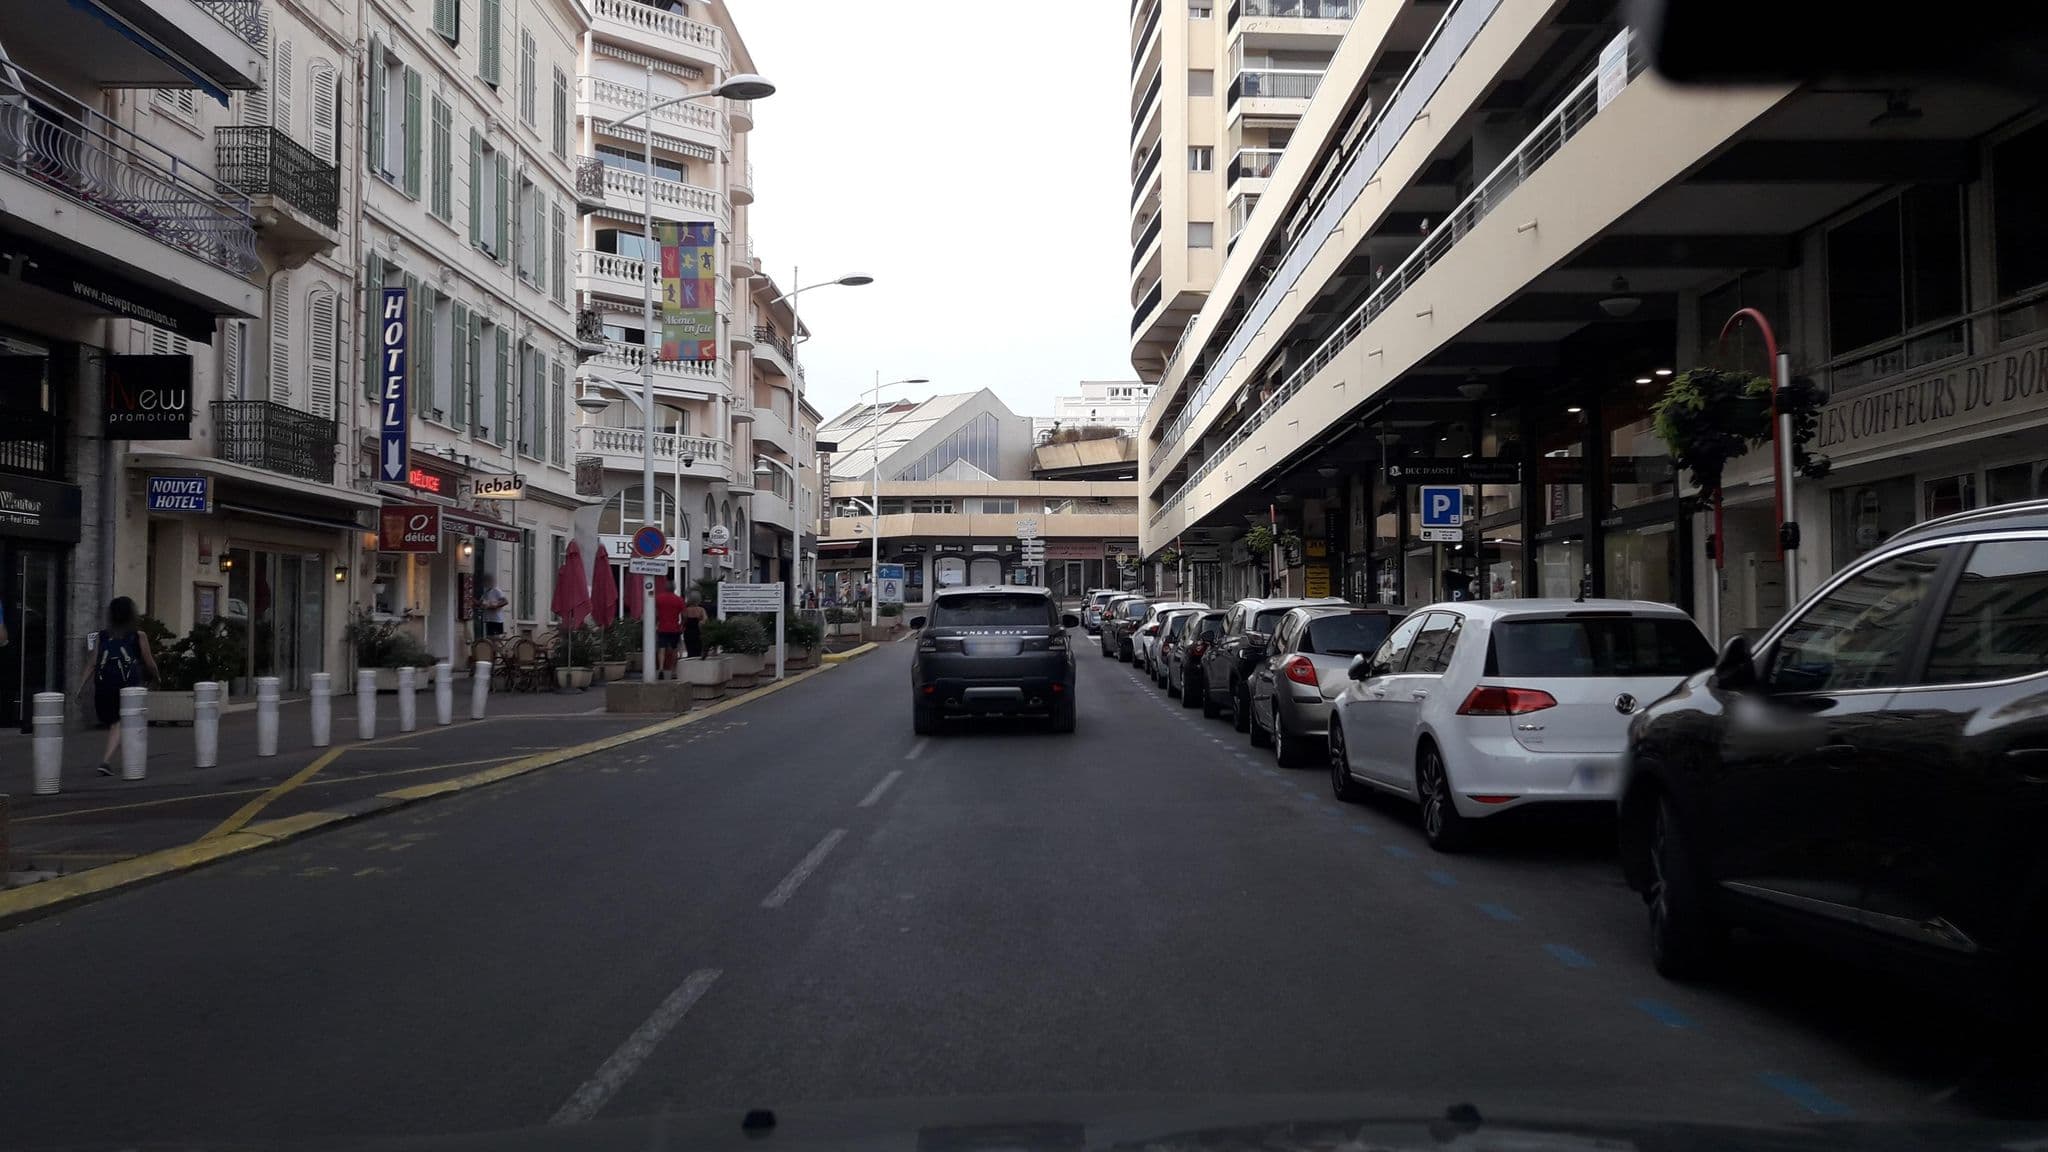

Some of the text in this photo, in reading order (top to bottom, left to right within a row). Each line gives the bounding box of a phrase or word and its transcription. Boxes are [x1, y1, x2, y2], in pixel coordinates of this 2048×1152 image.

[384, 295, 404, 427] HOTEL
[110, 371, 185, 410] New
[1818, 405, 1846, 447] LES
[1851, 373, 1957, 439] COIFFEURS
[1964, 361, 1998, 412] DU
[109, 413, 185, 424] promotion
[152, 480, 204, 494] NOUVEL
[474, 475, 523, 494] kebab
[1433, 494, 1451, 519] P
[404, 531, 437, 543] délice
